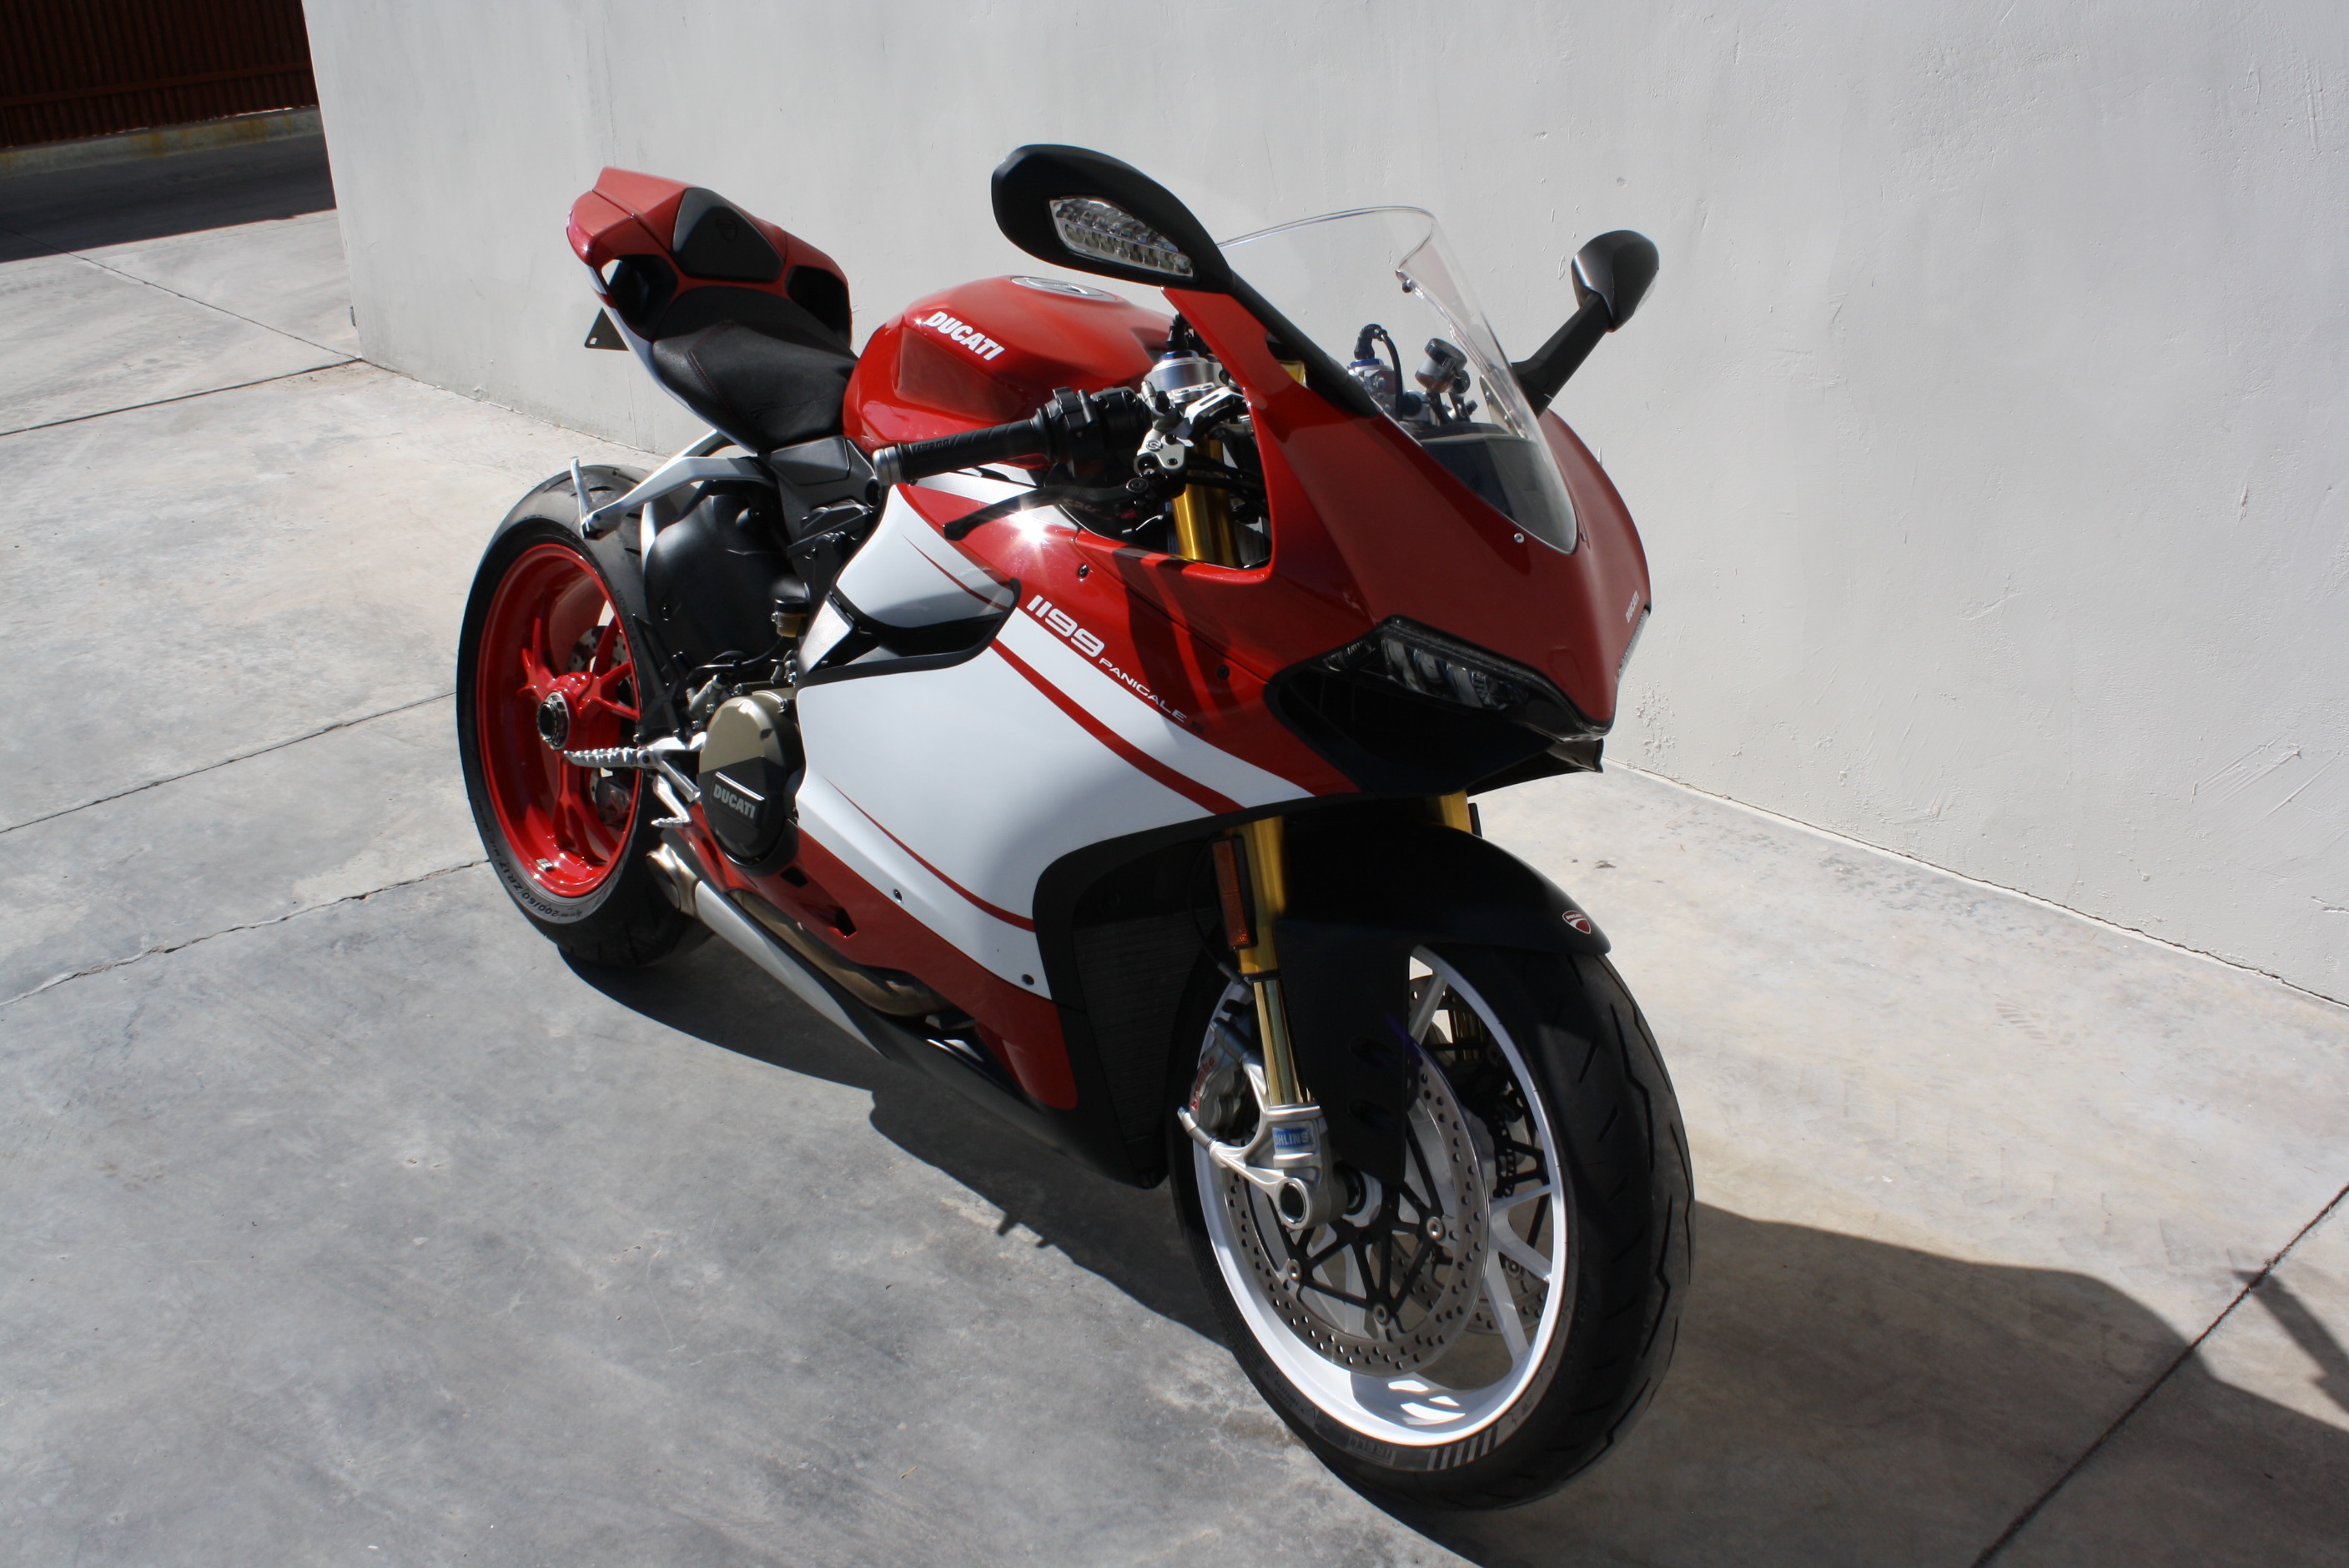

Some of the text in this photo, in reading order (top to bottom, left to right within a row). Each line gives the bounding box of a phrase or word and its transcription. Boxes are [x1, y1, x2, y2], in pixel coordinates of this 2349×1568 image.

[923, 311, 1005, 361] DUCATI
[1026, 594, 1105, 658] 1199
[1625, 590, 1639, 624] DUCATI
[712, 784, 756, 819] DUCATI
